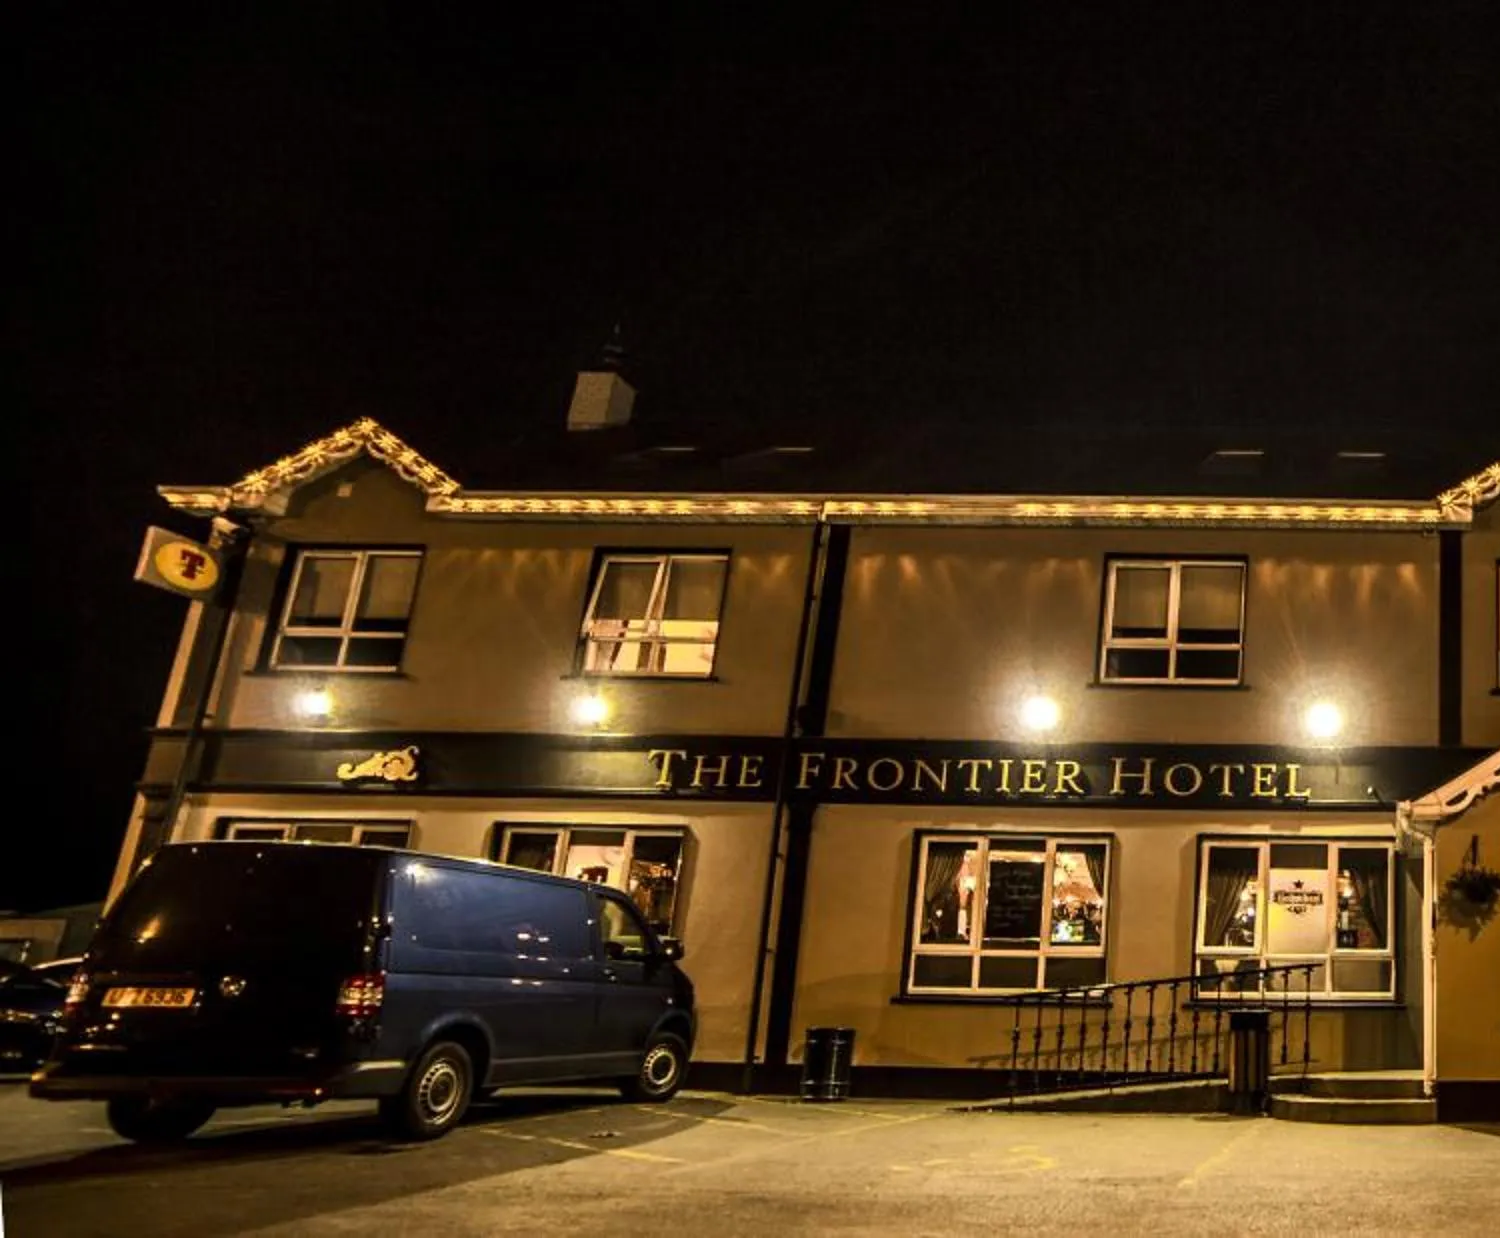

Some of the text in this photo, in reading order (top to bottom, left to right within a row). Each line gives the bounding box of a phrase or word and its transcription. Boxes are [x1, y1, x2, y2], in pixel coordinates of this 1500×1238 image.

[181, 549, 206, 581] T
[649, 750, 1312, 797] THE FRONTIER HOTEL
